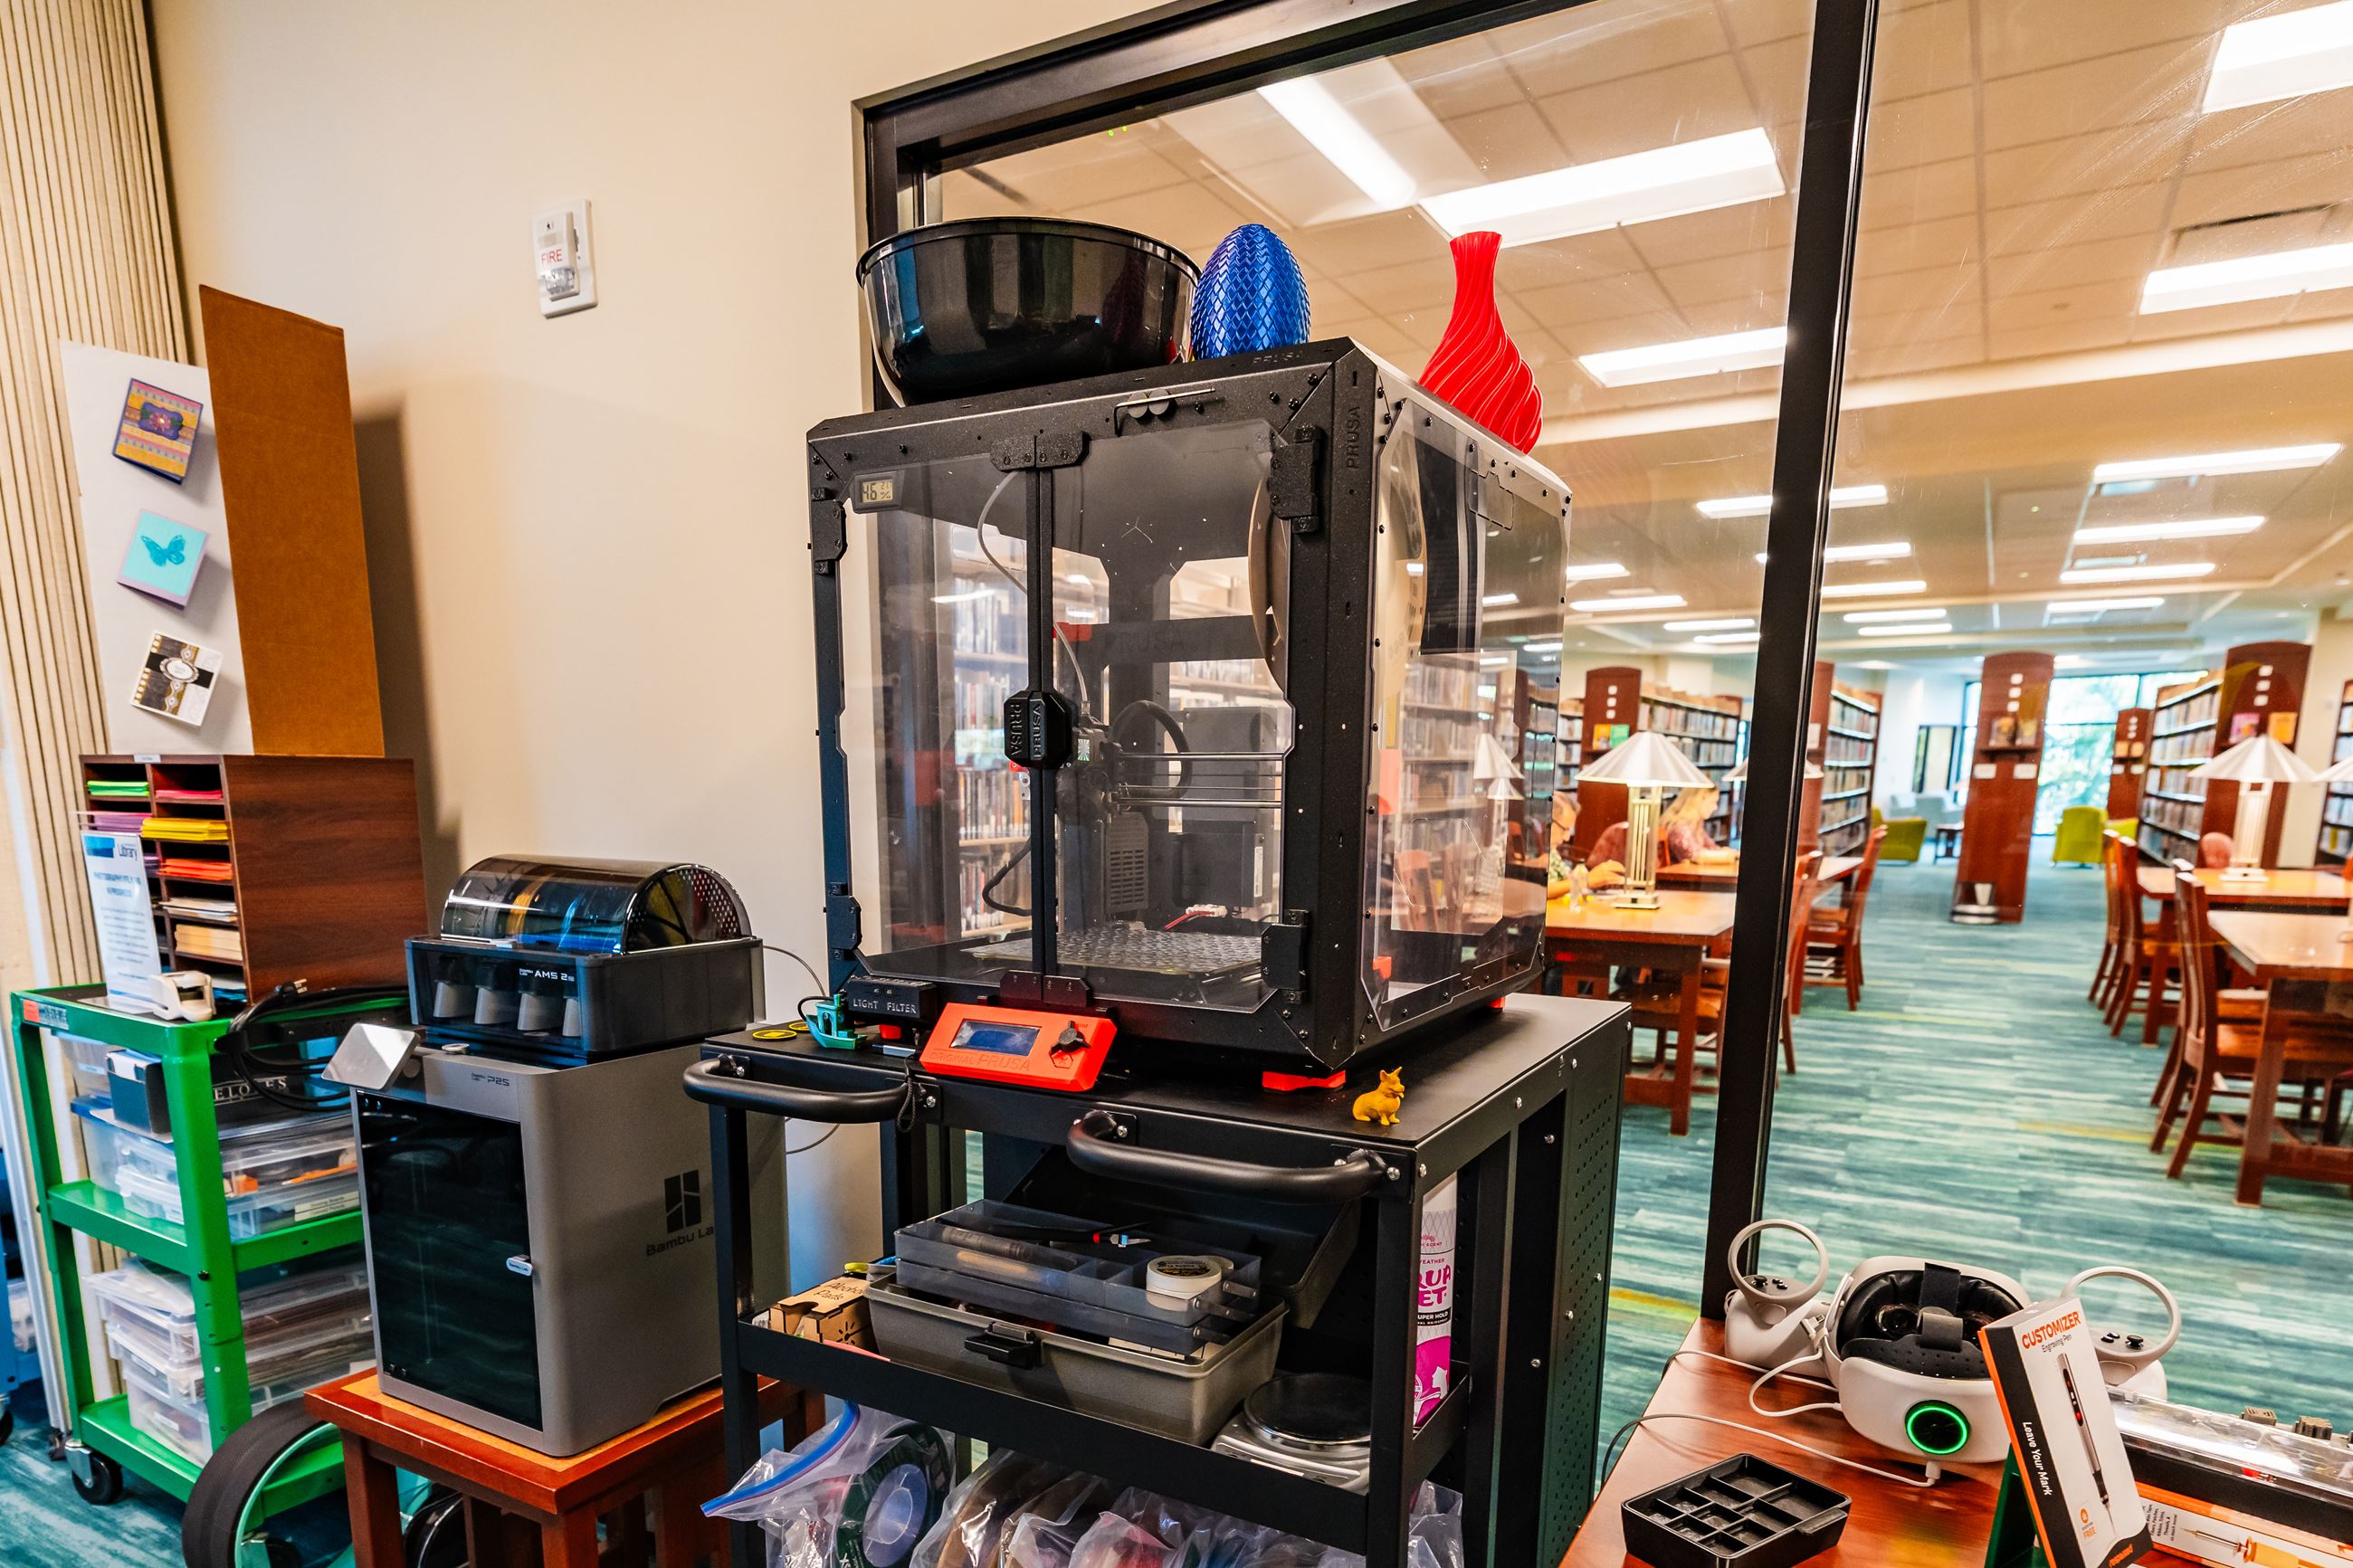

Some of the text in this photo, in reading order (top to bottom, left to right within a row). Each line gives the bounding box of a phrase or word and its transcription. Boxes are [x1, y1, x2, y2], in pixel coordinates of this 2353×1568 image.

[540, 249, 563, 264] FIRE
[1346, 406, 1360, 469] PRUSA
[1010, 704, 1023, 755] PRUSA
[1033, 705, 1043, 757] PRUSA
[534, 970, 558, 980] AMS
[853, 998, 917, 1014] LIGHT FILTER
[929, 1051, 1031, 1072] ORIGINAL PRUSA
[646, 1226, 714, 1257] Bambu La
[1419, 1264, 1451, 1289] QUA
[813, 1289, 844, 1300] Pads
[824, 1282, 863, 1295] Alcoho
[1418, 1286, 1447, 1307] ET
[1434, 1311, 1449, 1319] HOLD
[2021, 1310, 2082, 1350] CUSTOMIZER
[2042, 1334, 2072, 1354] Engraving Pen
[2022, 1421, 2053, 1496] Leave Your Mark
